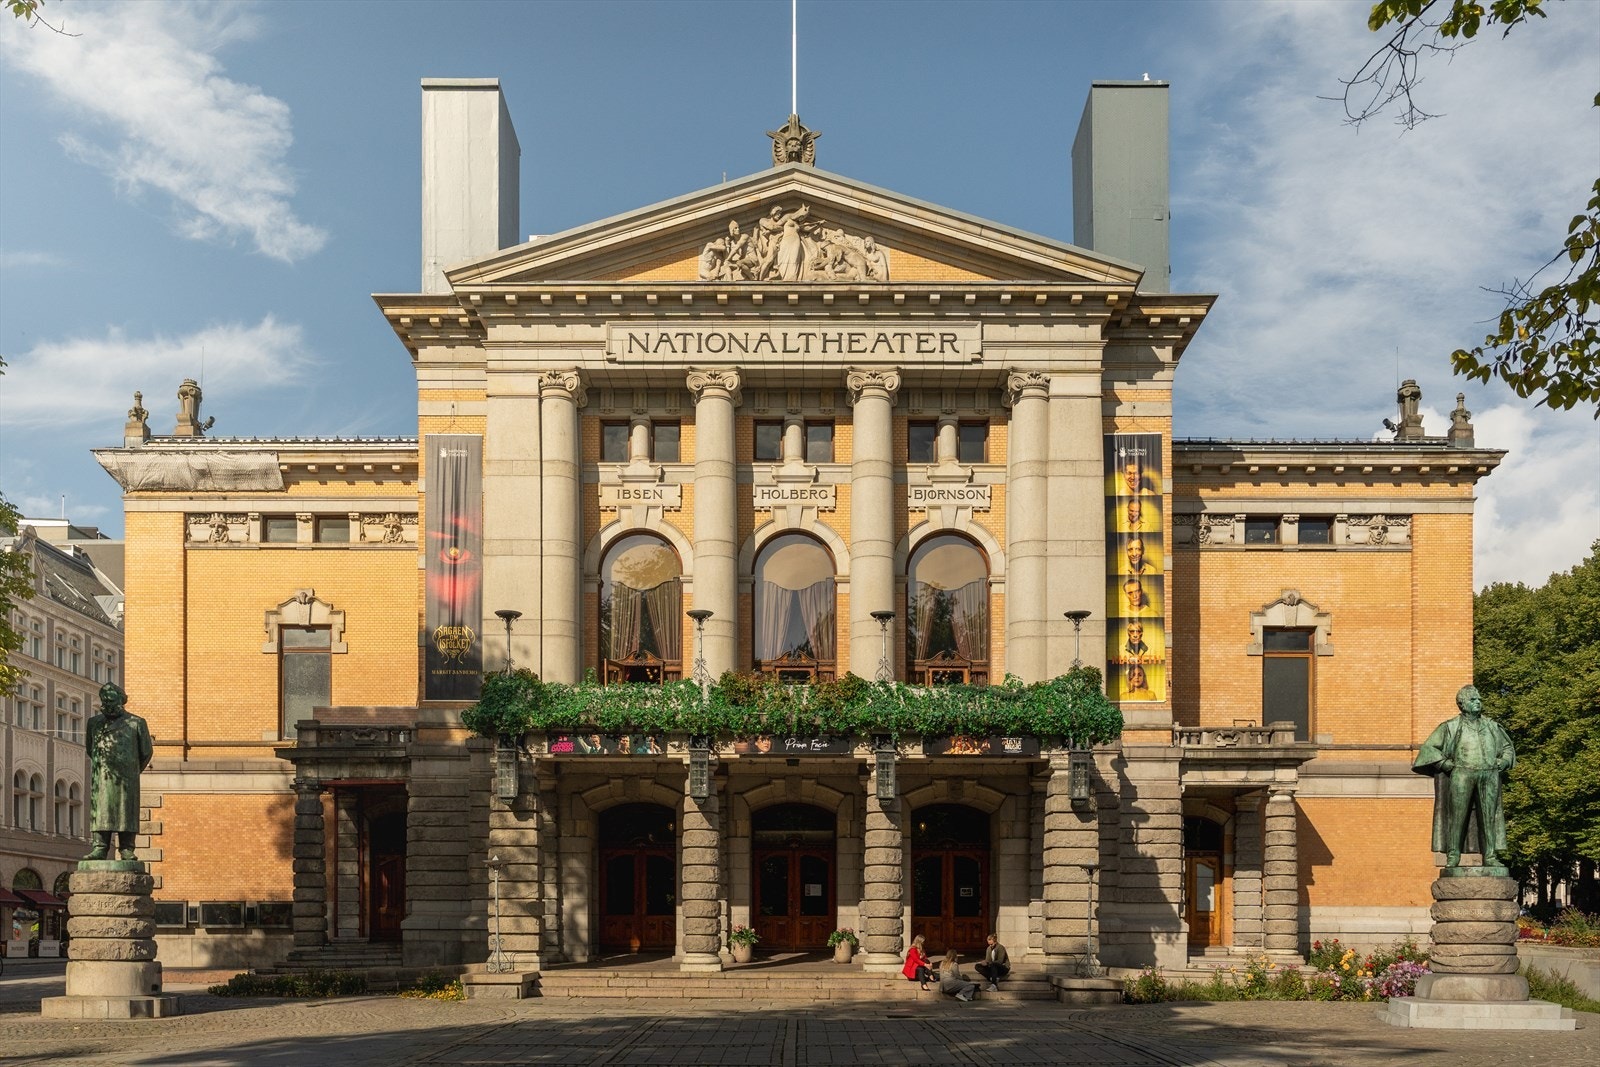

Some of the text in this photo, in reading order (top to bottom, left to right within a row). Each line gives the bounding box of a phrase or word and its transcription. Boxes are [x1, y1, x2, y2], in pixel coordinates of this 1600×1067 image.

[627, 331, 960, 354] NATIONALTHEATER
[616, 489, 664, 500] IBSEN
[760, 489, 829, 500] HOLBERG
[913, 489, 987, 502] BJØRNSON
[437, 625, 470, 637] SAGAEN
[439, 638, 471, 650] ISFOLKET
[1111, 655, 1162, 665] MACBETH
[784, 738, 807, 750] Prima
